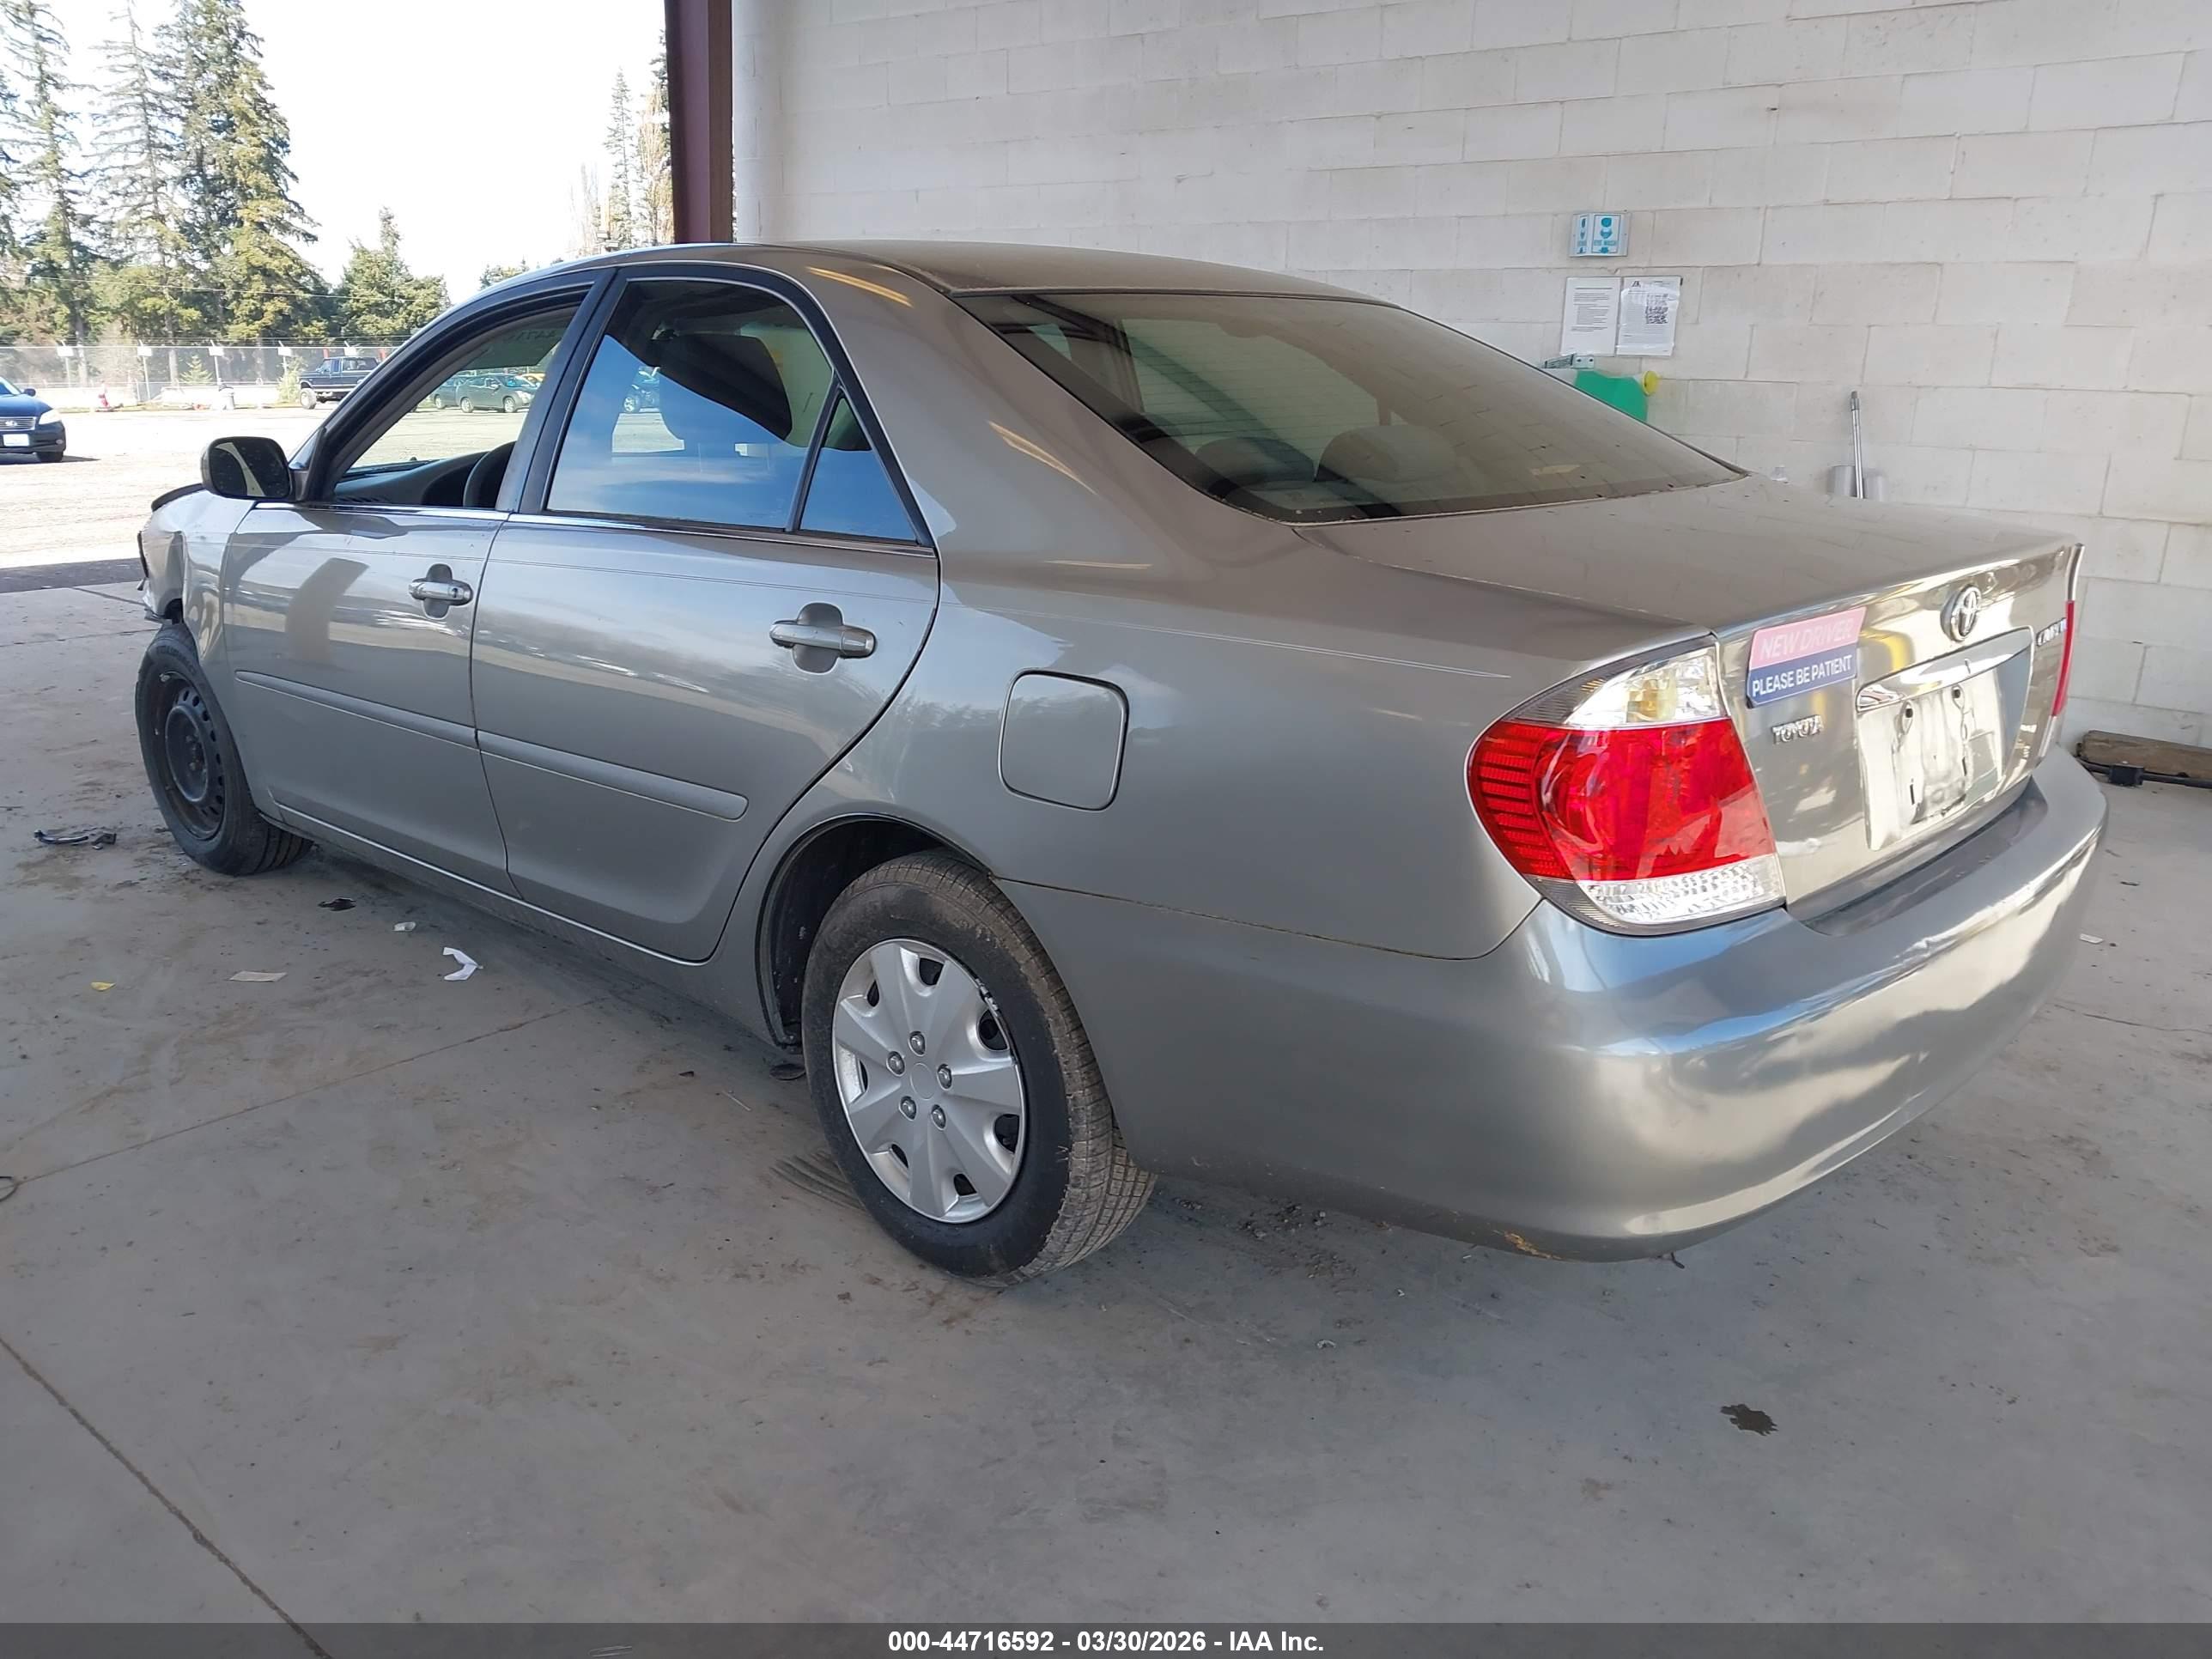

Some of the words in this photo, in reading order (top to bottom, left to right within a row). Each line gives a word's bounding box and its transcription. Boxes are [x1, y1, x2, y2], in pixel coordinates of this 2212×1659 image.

[1760, 631, 1801, 659] NEW
[1800, 619, 1855, 650] DRIVER
[1752, 670, 1795, 697] PLEASE
[1796, 666, 1811, 685] BE
[1811, 654, 1853, 681] PATIENT
[1771, 715, 1824, 744] TOYOTA
